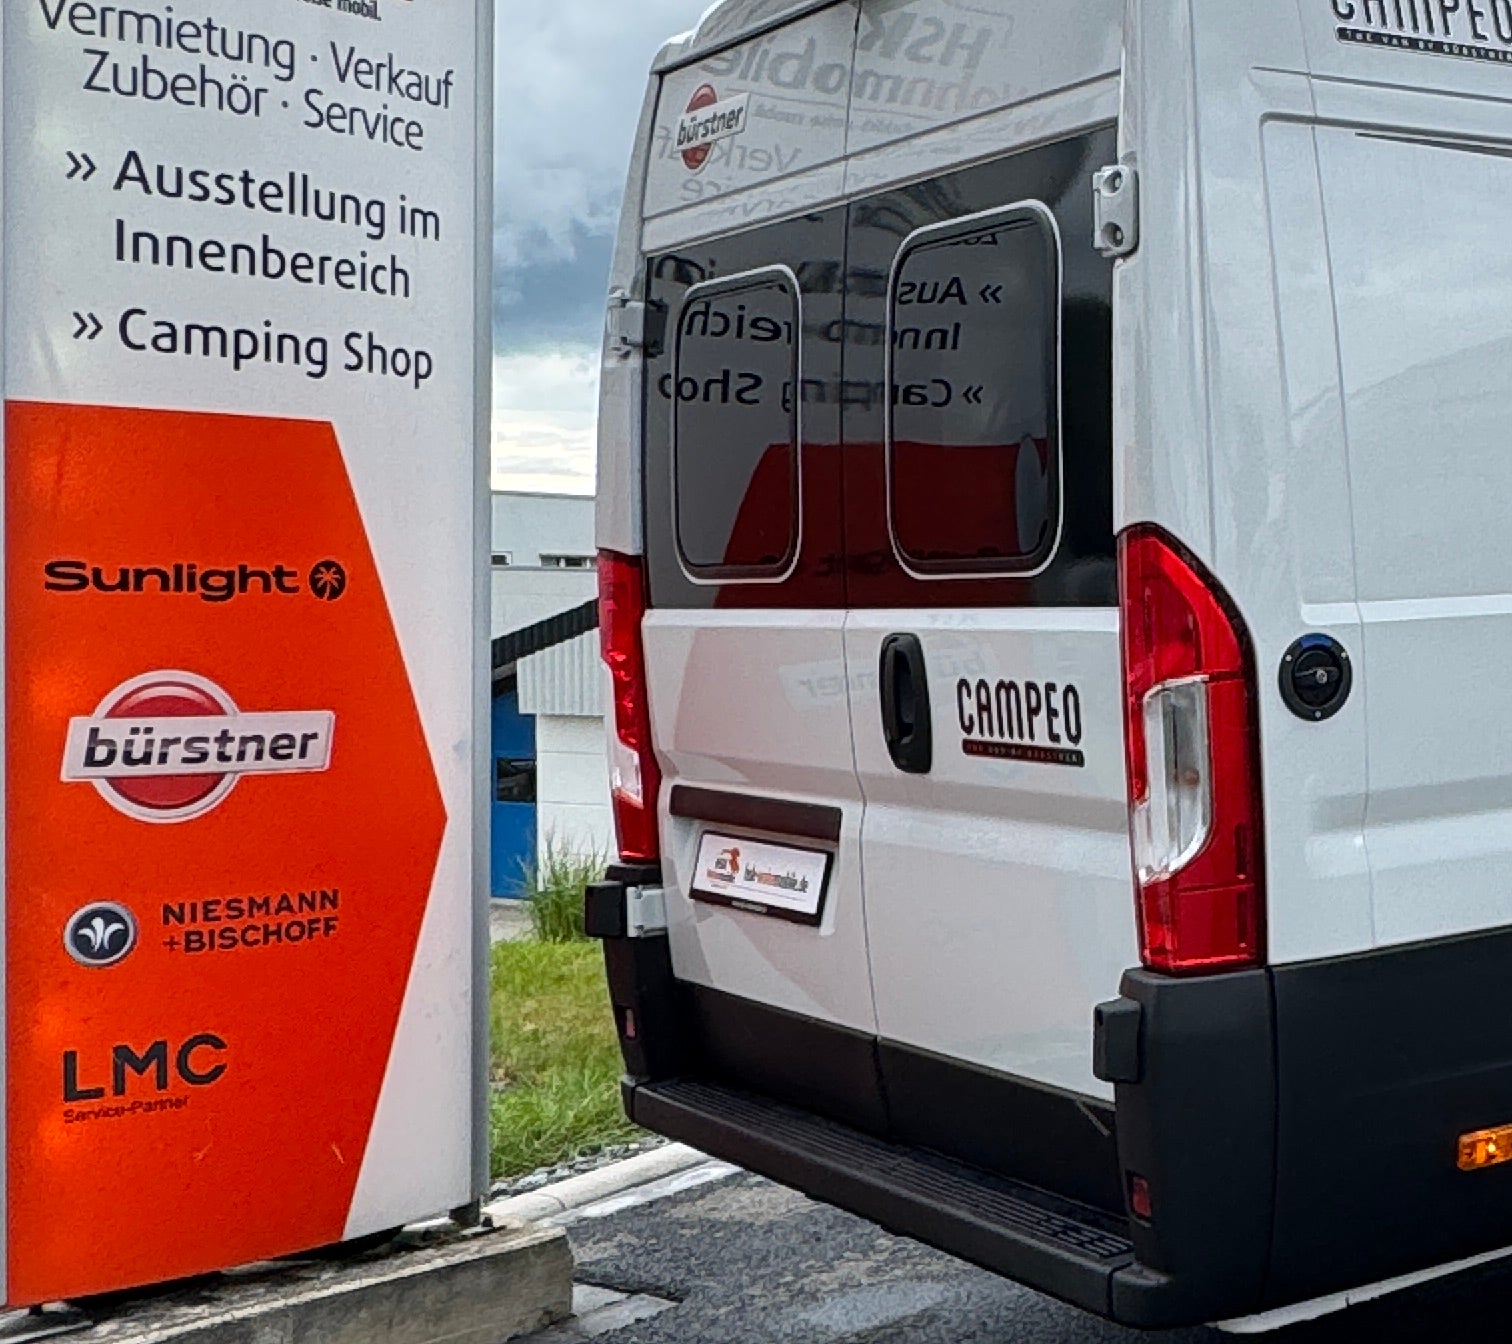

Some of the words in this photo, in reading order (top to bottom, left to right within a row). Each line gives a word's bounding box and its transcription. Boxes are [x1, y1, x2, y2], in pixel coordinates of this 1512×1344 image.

[83, 49, 268, 117] Zubehör
[304, 89, 424, 151] Service
[330, 40, 454, 109] Verkauf
[677, 103, 744, 147] bürstner
[113, 150, 386, 241] Ausstellung
[399, 195, 441, 241] im
[115, 219, 410, 298] Innenbereich
[118, 308, 328, 379] Camping
[344, 331, 433, 390] Shop
[44, 560, 301, 603] Sunlight
[957, 677, 1082, 747] CAMPEO
[83, 726, 318, 769] bürstner
[162, 888, 340, 926] NIESMANN
[162, 916, 339, 954] +BISCHOFF
[63, 1033, 228, 1104] LMC
